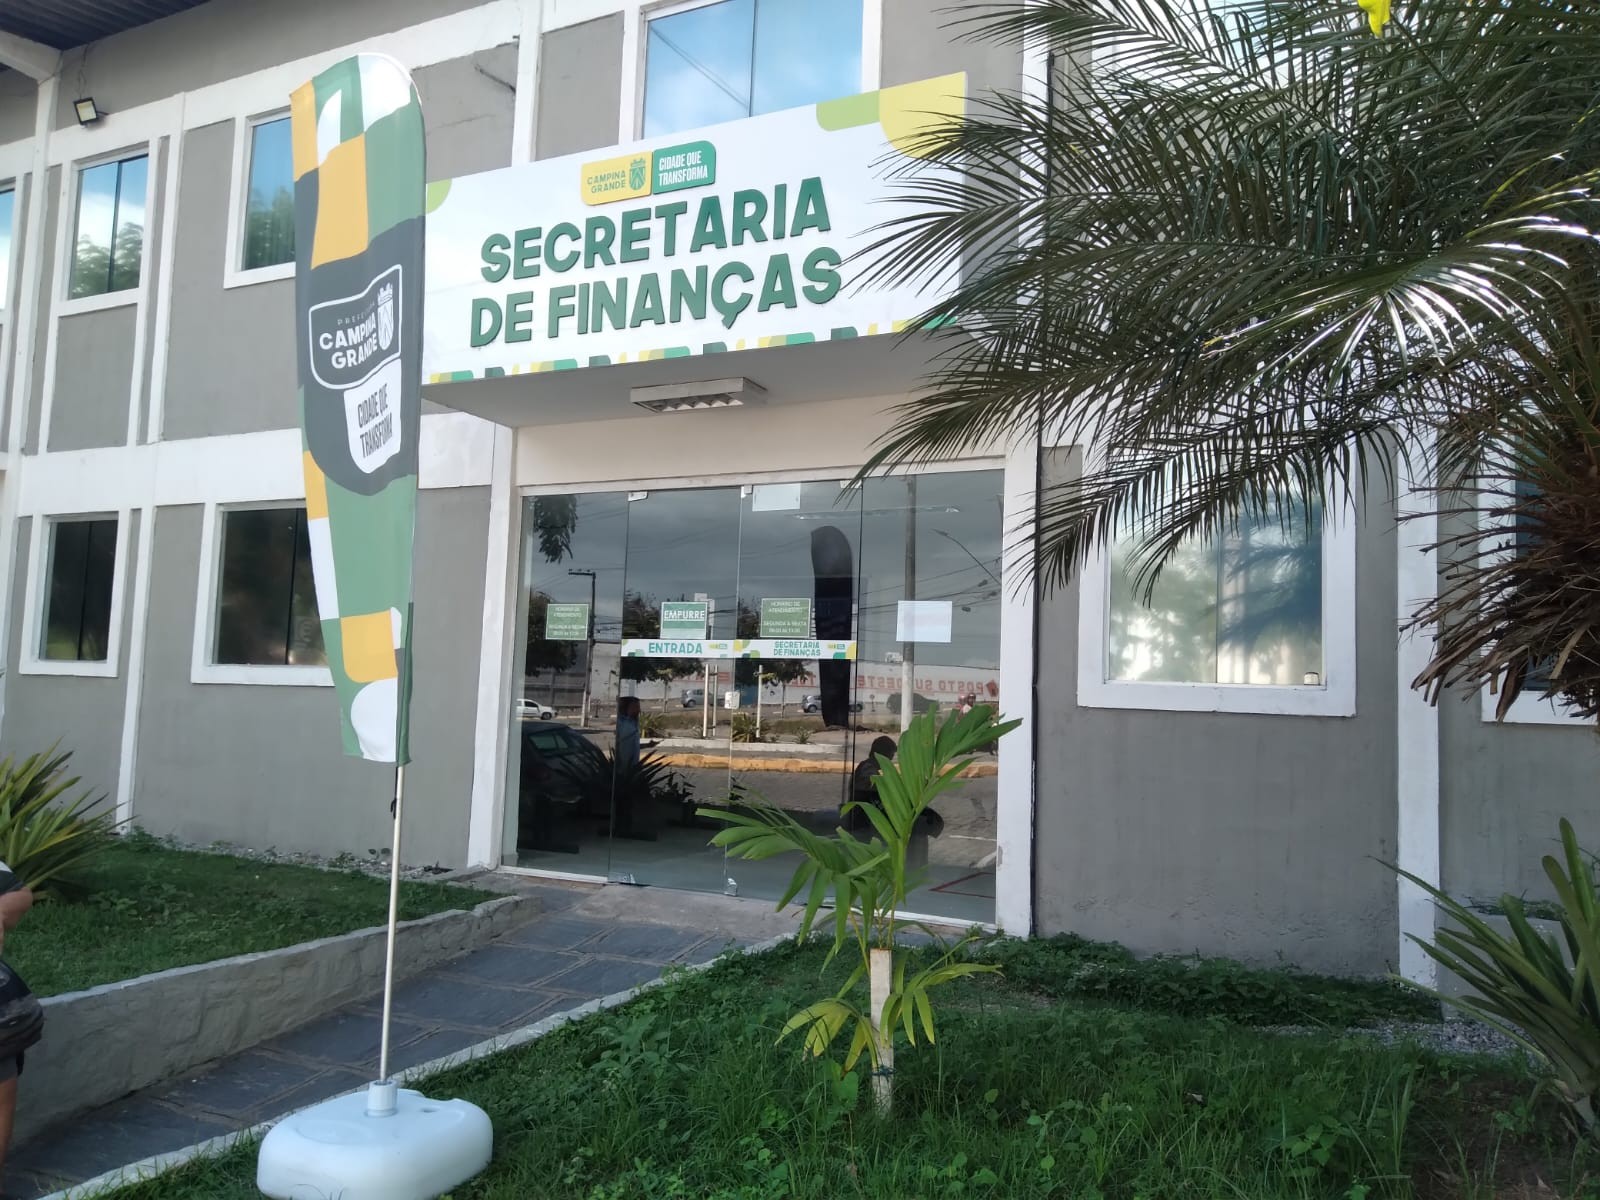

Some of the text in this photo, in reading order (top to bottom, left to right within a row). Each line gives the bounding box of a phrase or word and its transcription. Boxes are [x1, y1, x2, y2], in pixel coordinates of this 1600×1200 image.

[658, 150, 702, 171] CIDADE QUE
[587, 170, 626, 185] CAMPINA
[591, 180, 626, 193] GRANDE
[658, 165, 709, 187] TRANSFORMA
[480, 176, 832, 284] SECRETARIA
[470, 246, 843, 348] DE FINANÇAS
[319, 311, 377, 350] CAMPINA
[331, 333, 378, 369] GRANDE
[357, 383, 389, 429] CIDADE QUE
[359, 412, 393, 458] TRANSFORMA
[664, 610, 705, 620] EMPURRE
[648, 642, 703, 654] ENTRADA
[774, 641, 820, 649] SECRETARIA
[783, 649, 820, 658] FINANÇAS
